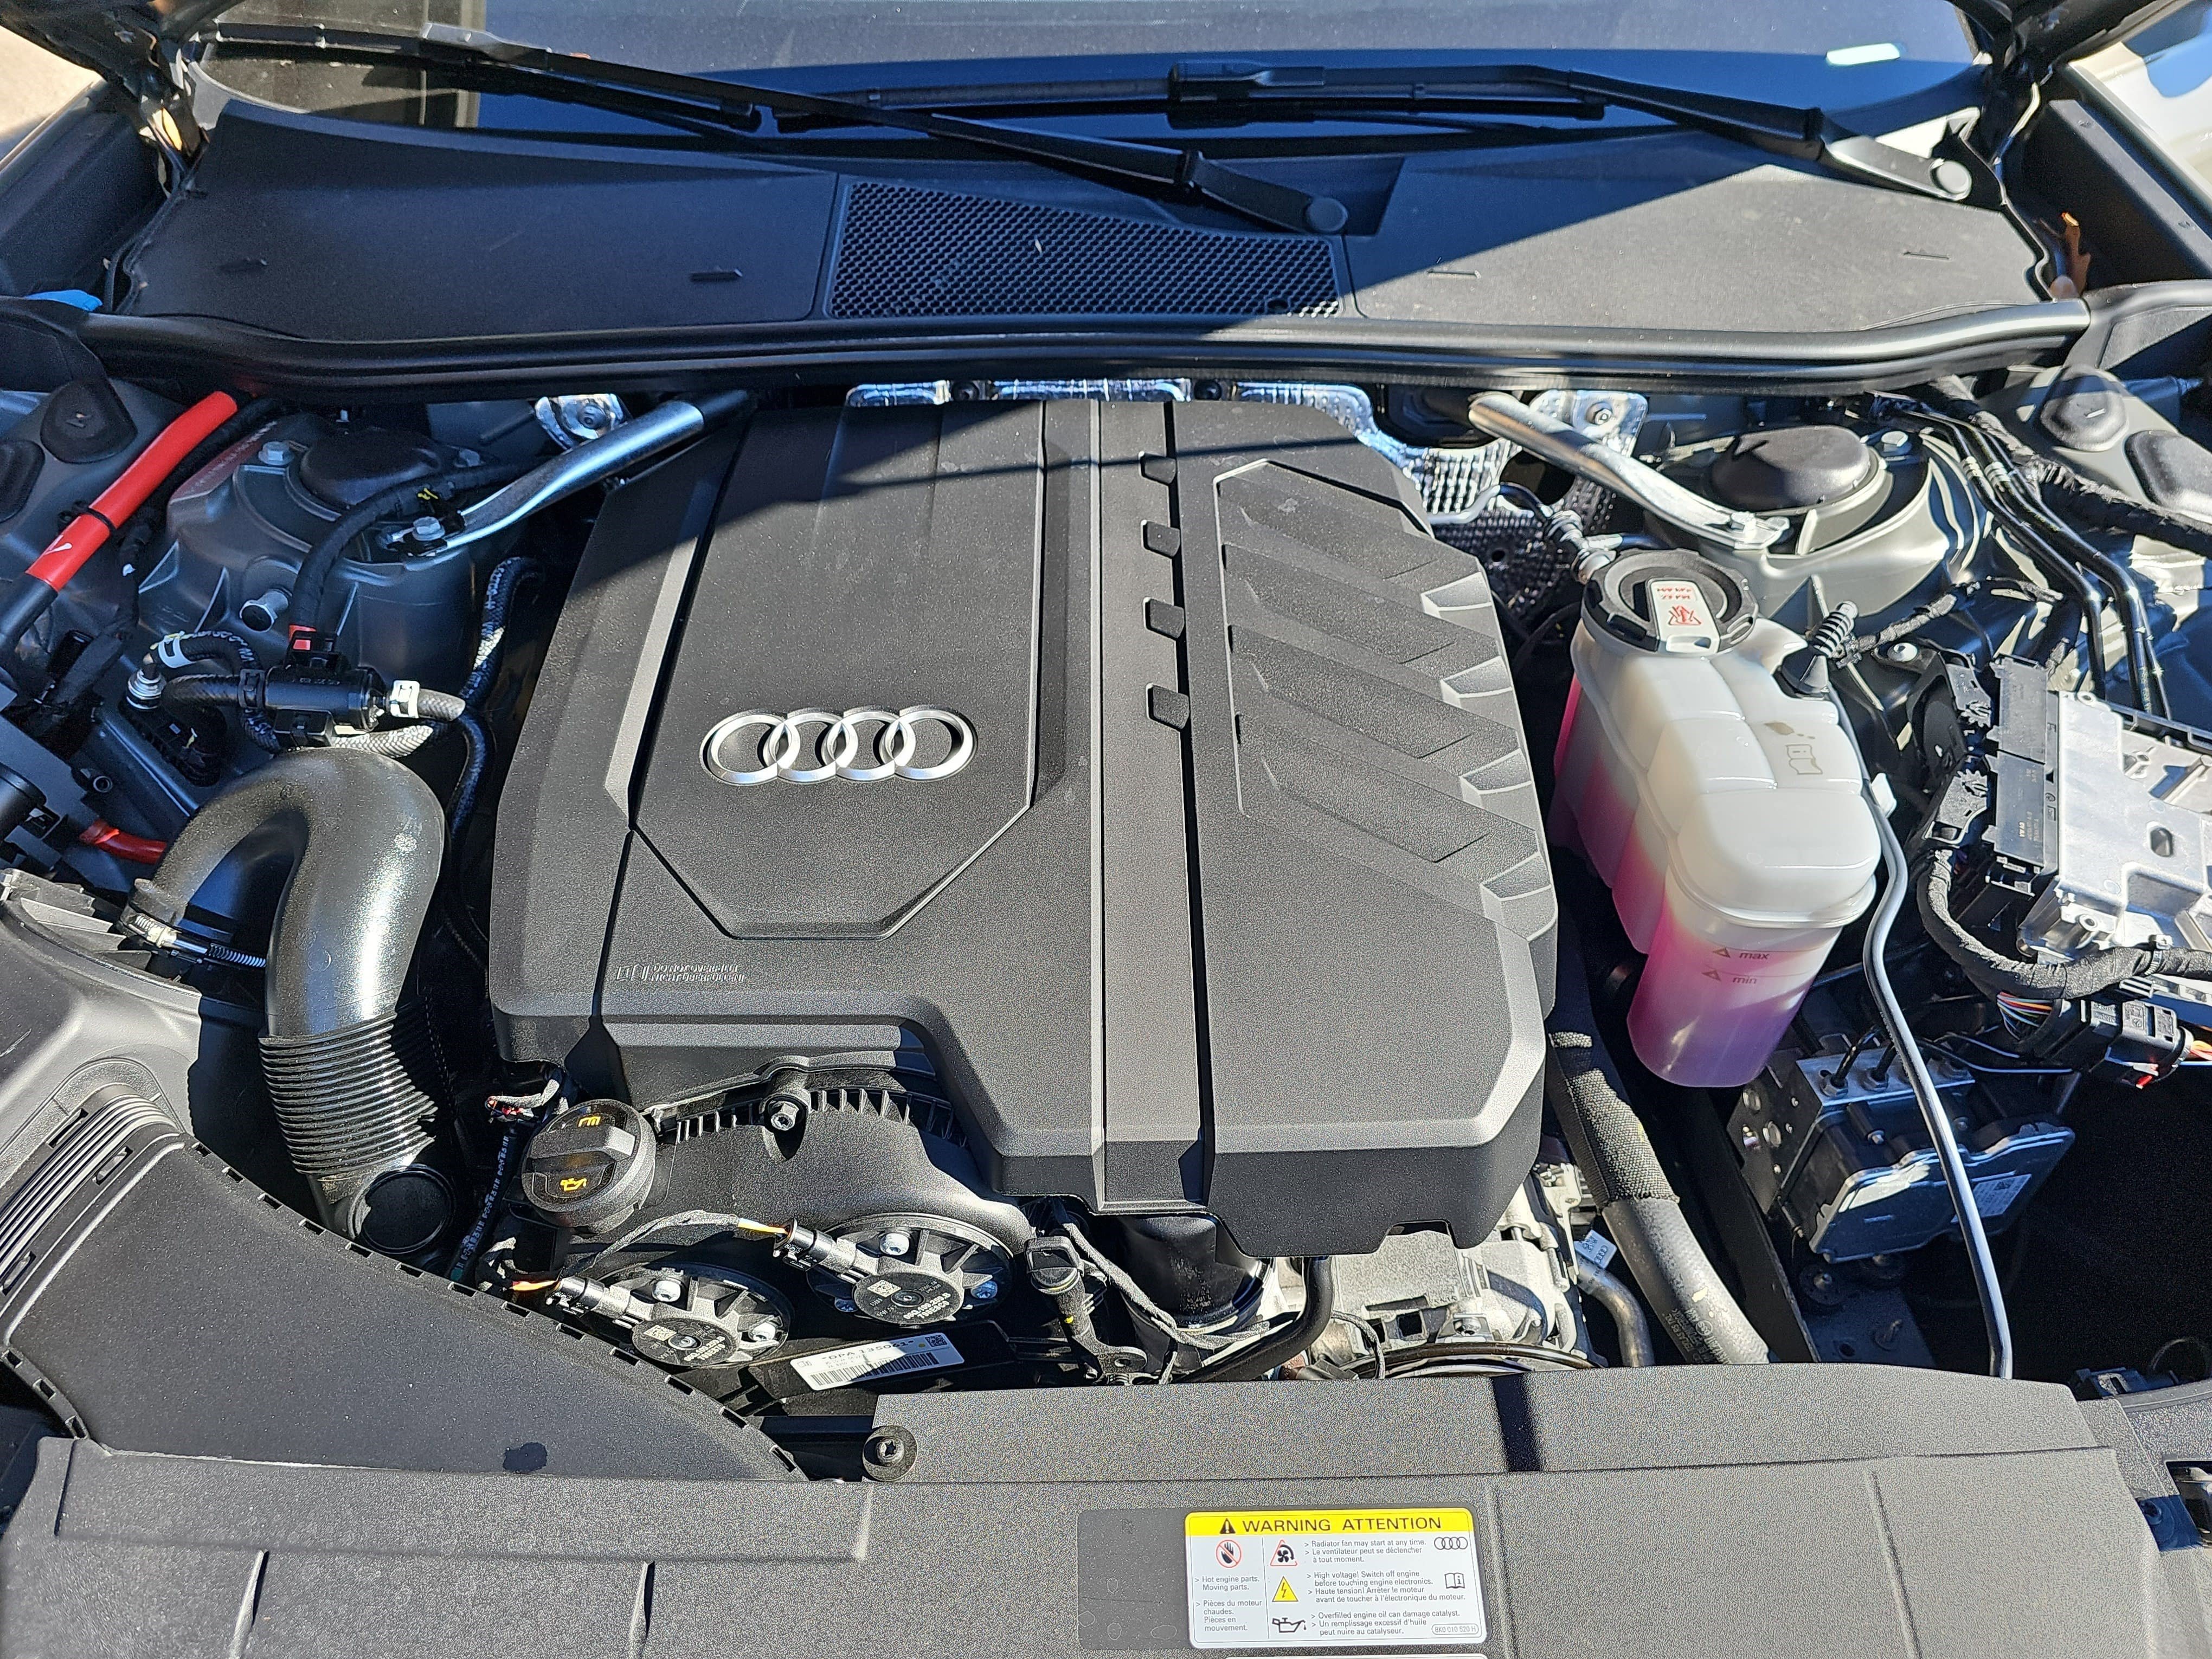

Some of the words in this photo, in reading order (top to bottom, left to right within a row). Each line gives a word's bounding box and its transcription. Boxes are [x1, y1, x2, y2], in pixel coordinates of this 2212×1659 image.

[1242, 1519, 1330, 1532] WARNING
[1342, 1516, 1441, 1531] ATTENTION
[1215, 1575, 1239, 1583] engine
[1314, 1571, 1330, 1580] High
[1331, 1570, 1359, 1579] voltage!
[1396, 1570, 1419, 1578] engine
[1338, 1578, 1368, 1587] touching
[1202, 1583, 1228, 1591] Moving
[1336, 1586, 1365, 1594] tension!
[1366, 1586, 1390, 1594] Arrêter
[1380, 1593, 1427, 1602] l'électronique
[1203, 1607, 1234, 1615] chaudes.
[1317, 1611, 1352, 1619] Overfilled
[1353, 1610, 1377, 1619] engine
[1402, 1610, 1430, 1618] damage
[1431, 1609, 1460, 1618] catalyst.
[1204, 1615, 1226, 1623] Pièces
[1330, 1619, 1373, 1628] remplissage
[1374, 1618, 1401, 1626] excessif
[1336, 1627, 1355, 1635] nuire
[1366, 1627, 1404, 1635] catalyseur.
